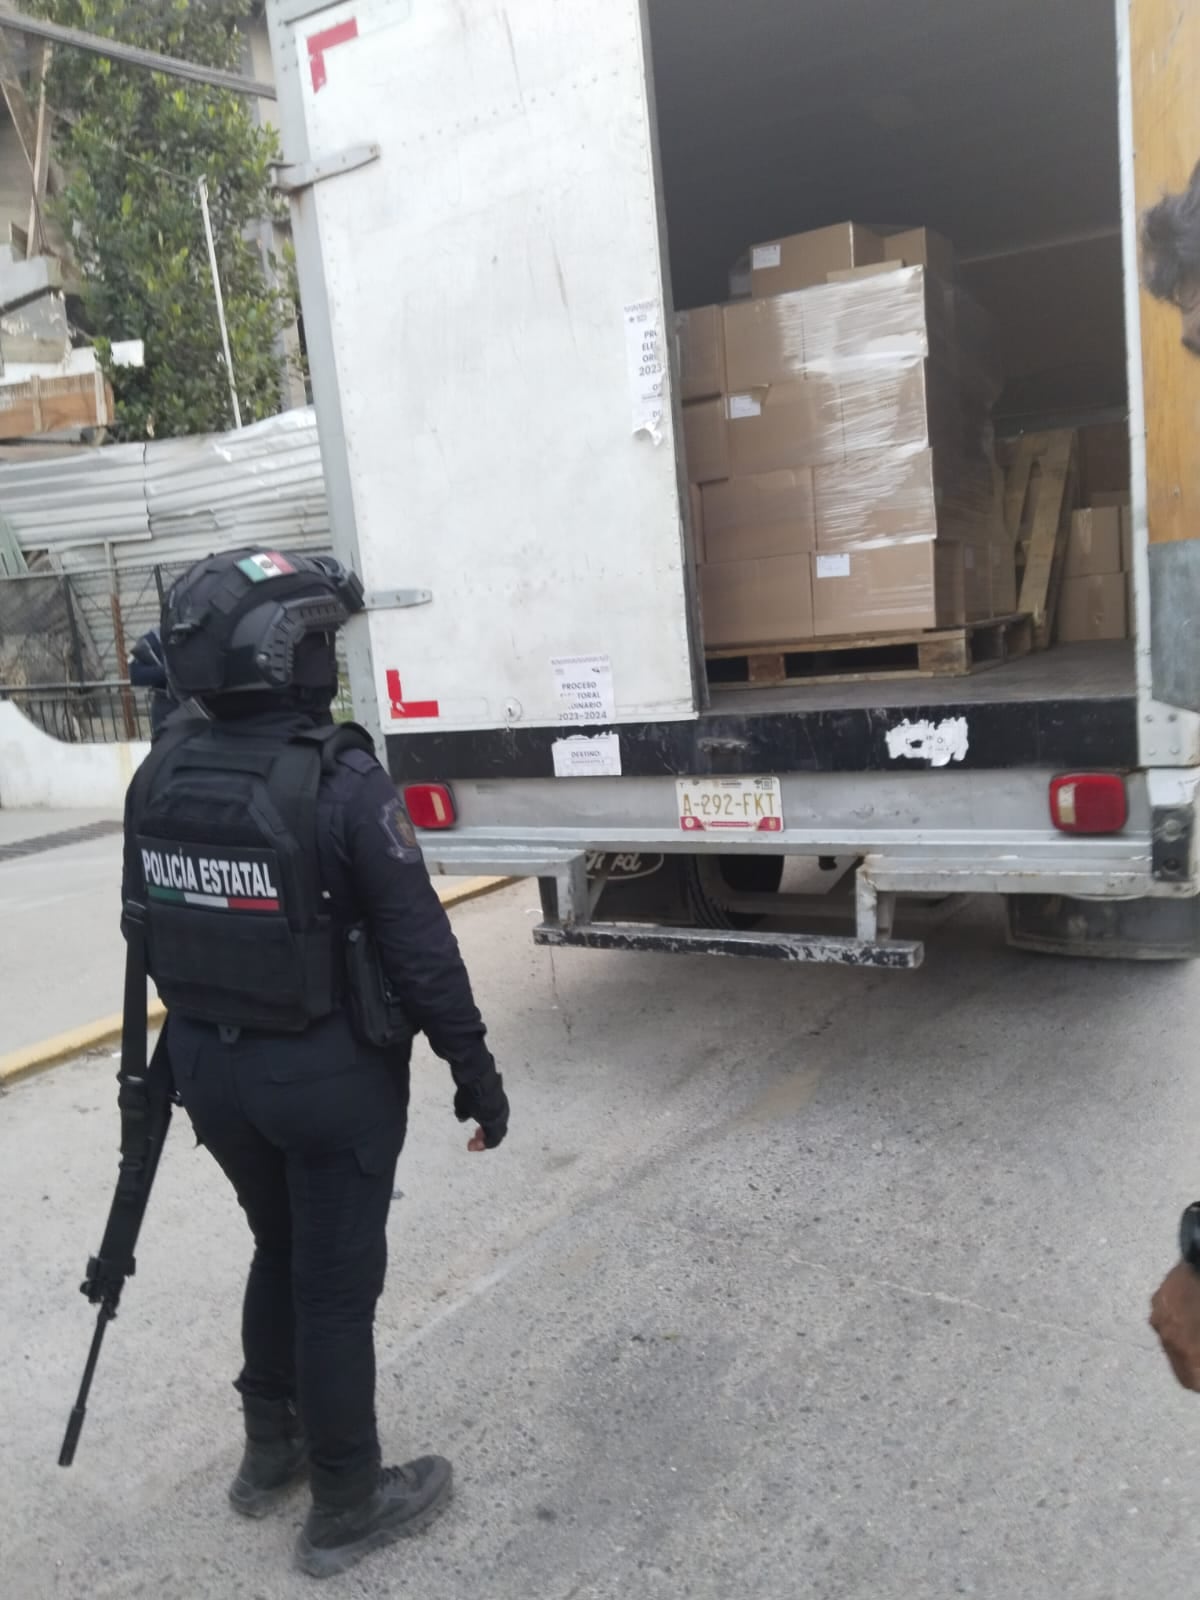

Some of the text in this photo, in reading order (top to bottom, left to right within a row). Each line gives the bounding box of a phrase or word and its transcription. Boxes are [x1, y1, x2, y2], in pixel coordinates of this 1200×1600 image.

[642, 342, 656, 351] ELE
[642, 354, 656, 363] OR
[562, 681, 597, 690] PROCESO
[683, 792, 775, 816] A-292-FKT
[141, 847, 278, 897] POLICÍA ESTATAL
